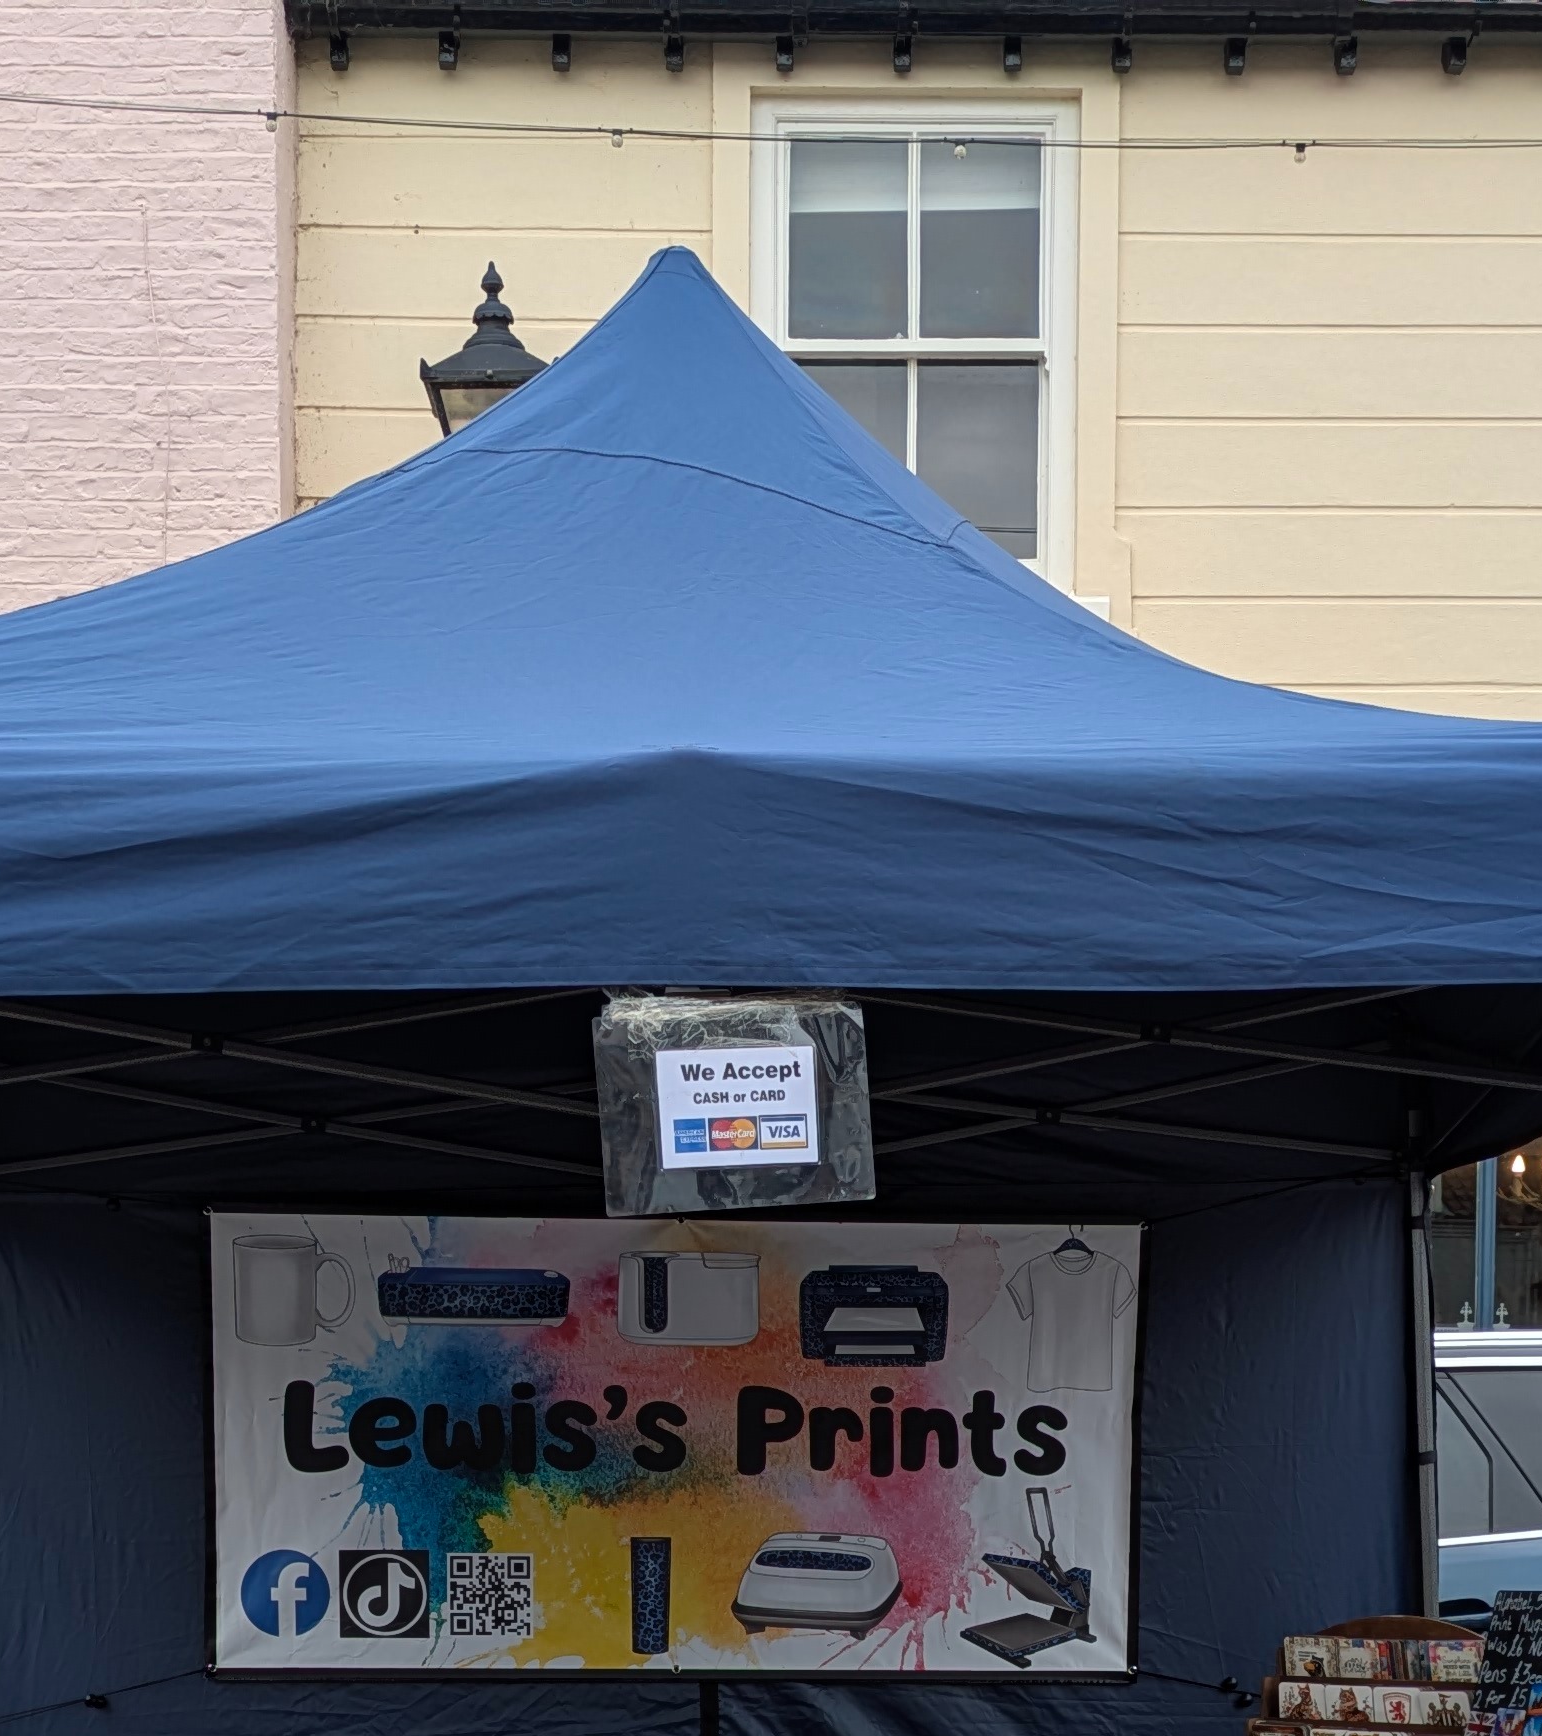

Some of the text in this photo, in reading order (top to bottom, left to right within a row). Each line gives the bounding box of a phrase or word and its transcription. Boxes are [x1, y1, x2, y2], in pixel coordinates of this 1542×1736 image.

[681, 1061, 801, 1082] We Accept
[693, 1090, 785, 1104] CASH or CARD
[712, 1129, 755, 1139] MasterCard
[767, 1126, 800, 1138] VISA
[282, 1378, 1070, 1477] Lewis's Prints
[1490, 1615, 1512, 1632] Print
[1478, 1661, 1507, 1684] Pens
[1473, 1690, 1482, 1709] 2
[1510, 1685, 1528, 1708] £5
